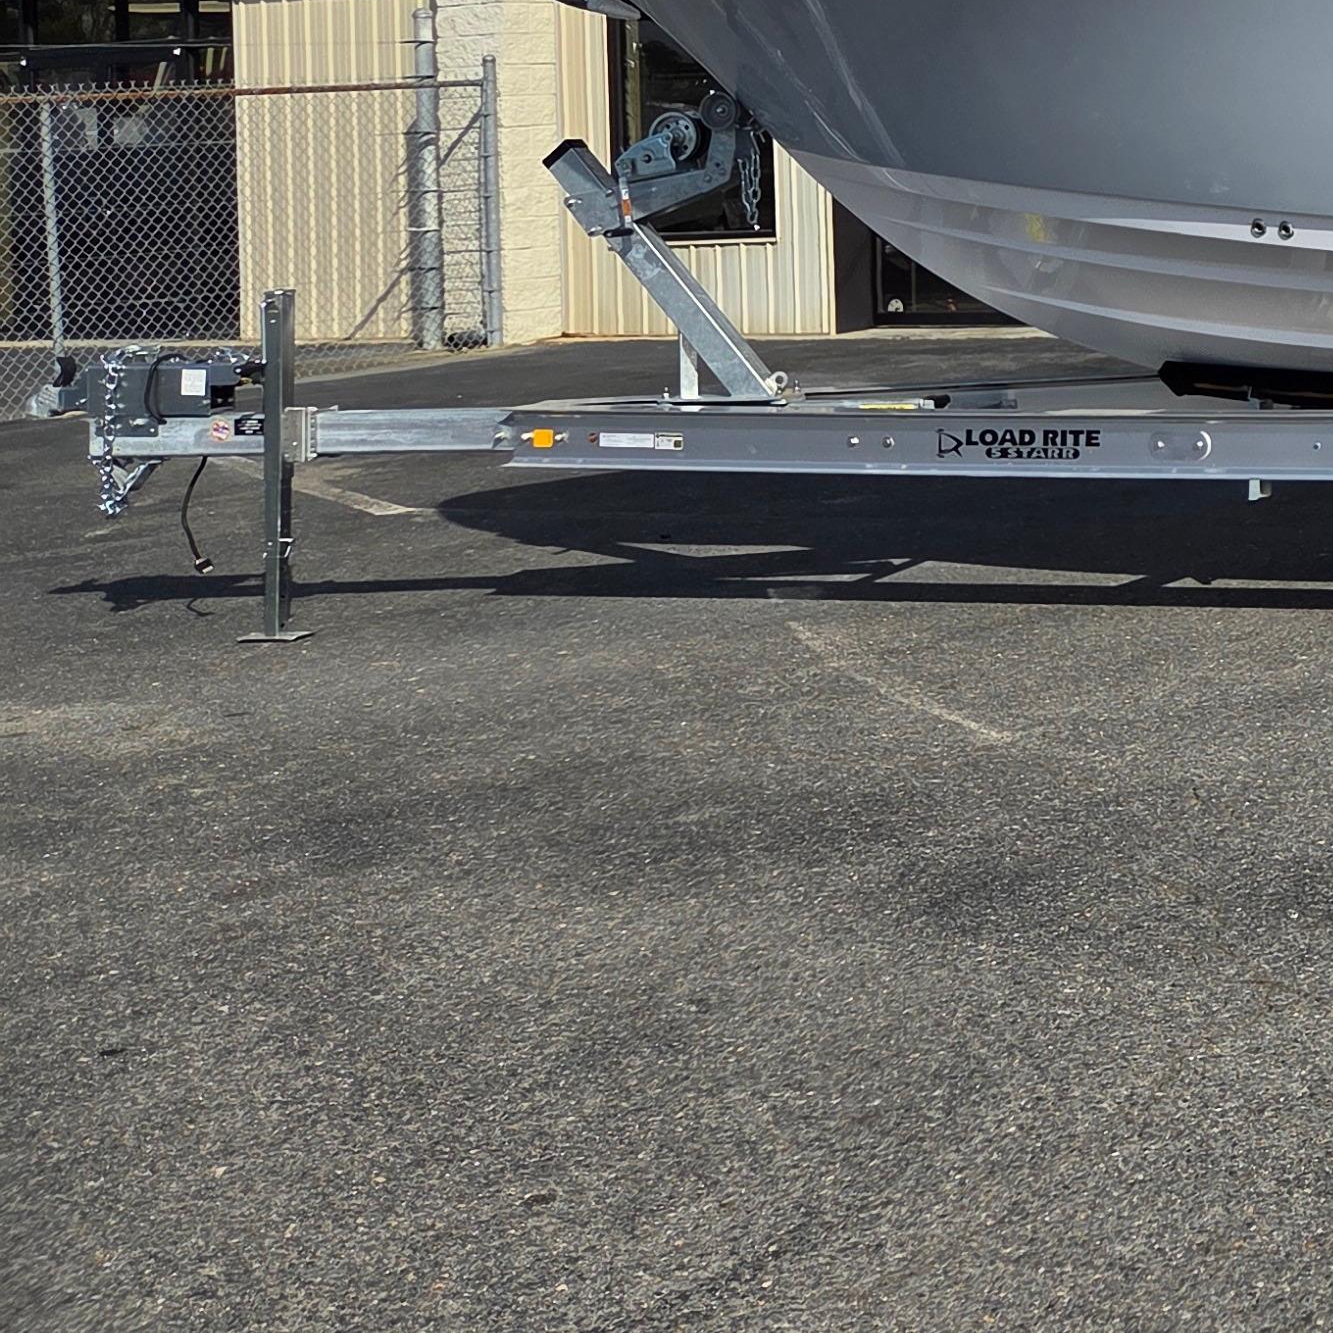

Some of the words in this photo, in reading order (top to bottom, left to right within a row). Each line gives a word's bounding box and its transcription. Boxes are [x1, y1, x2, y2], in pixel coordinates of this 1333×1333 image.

[965, 429, 1036, 446] LOAD
[1042, 429, 1101, 447] RITE
[990, 448, 1002, 458] 5
[1007, 448, 1075, 459] STARR
